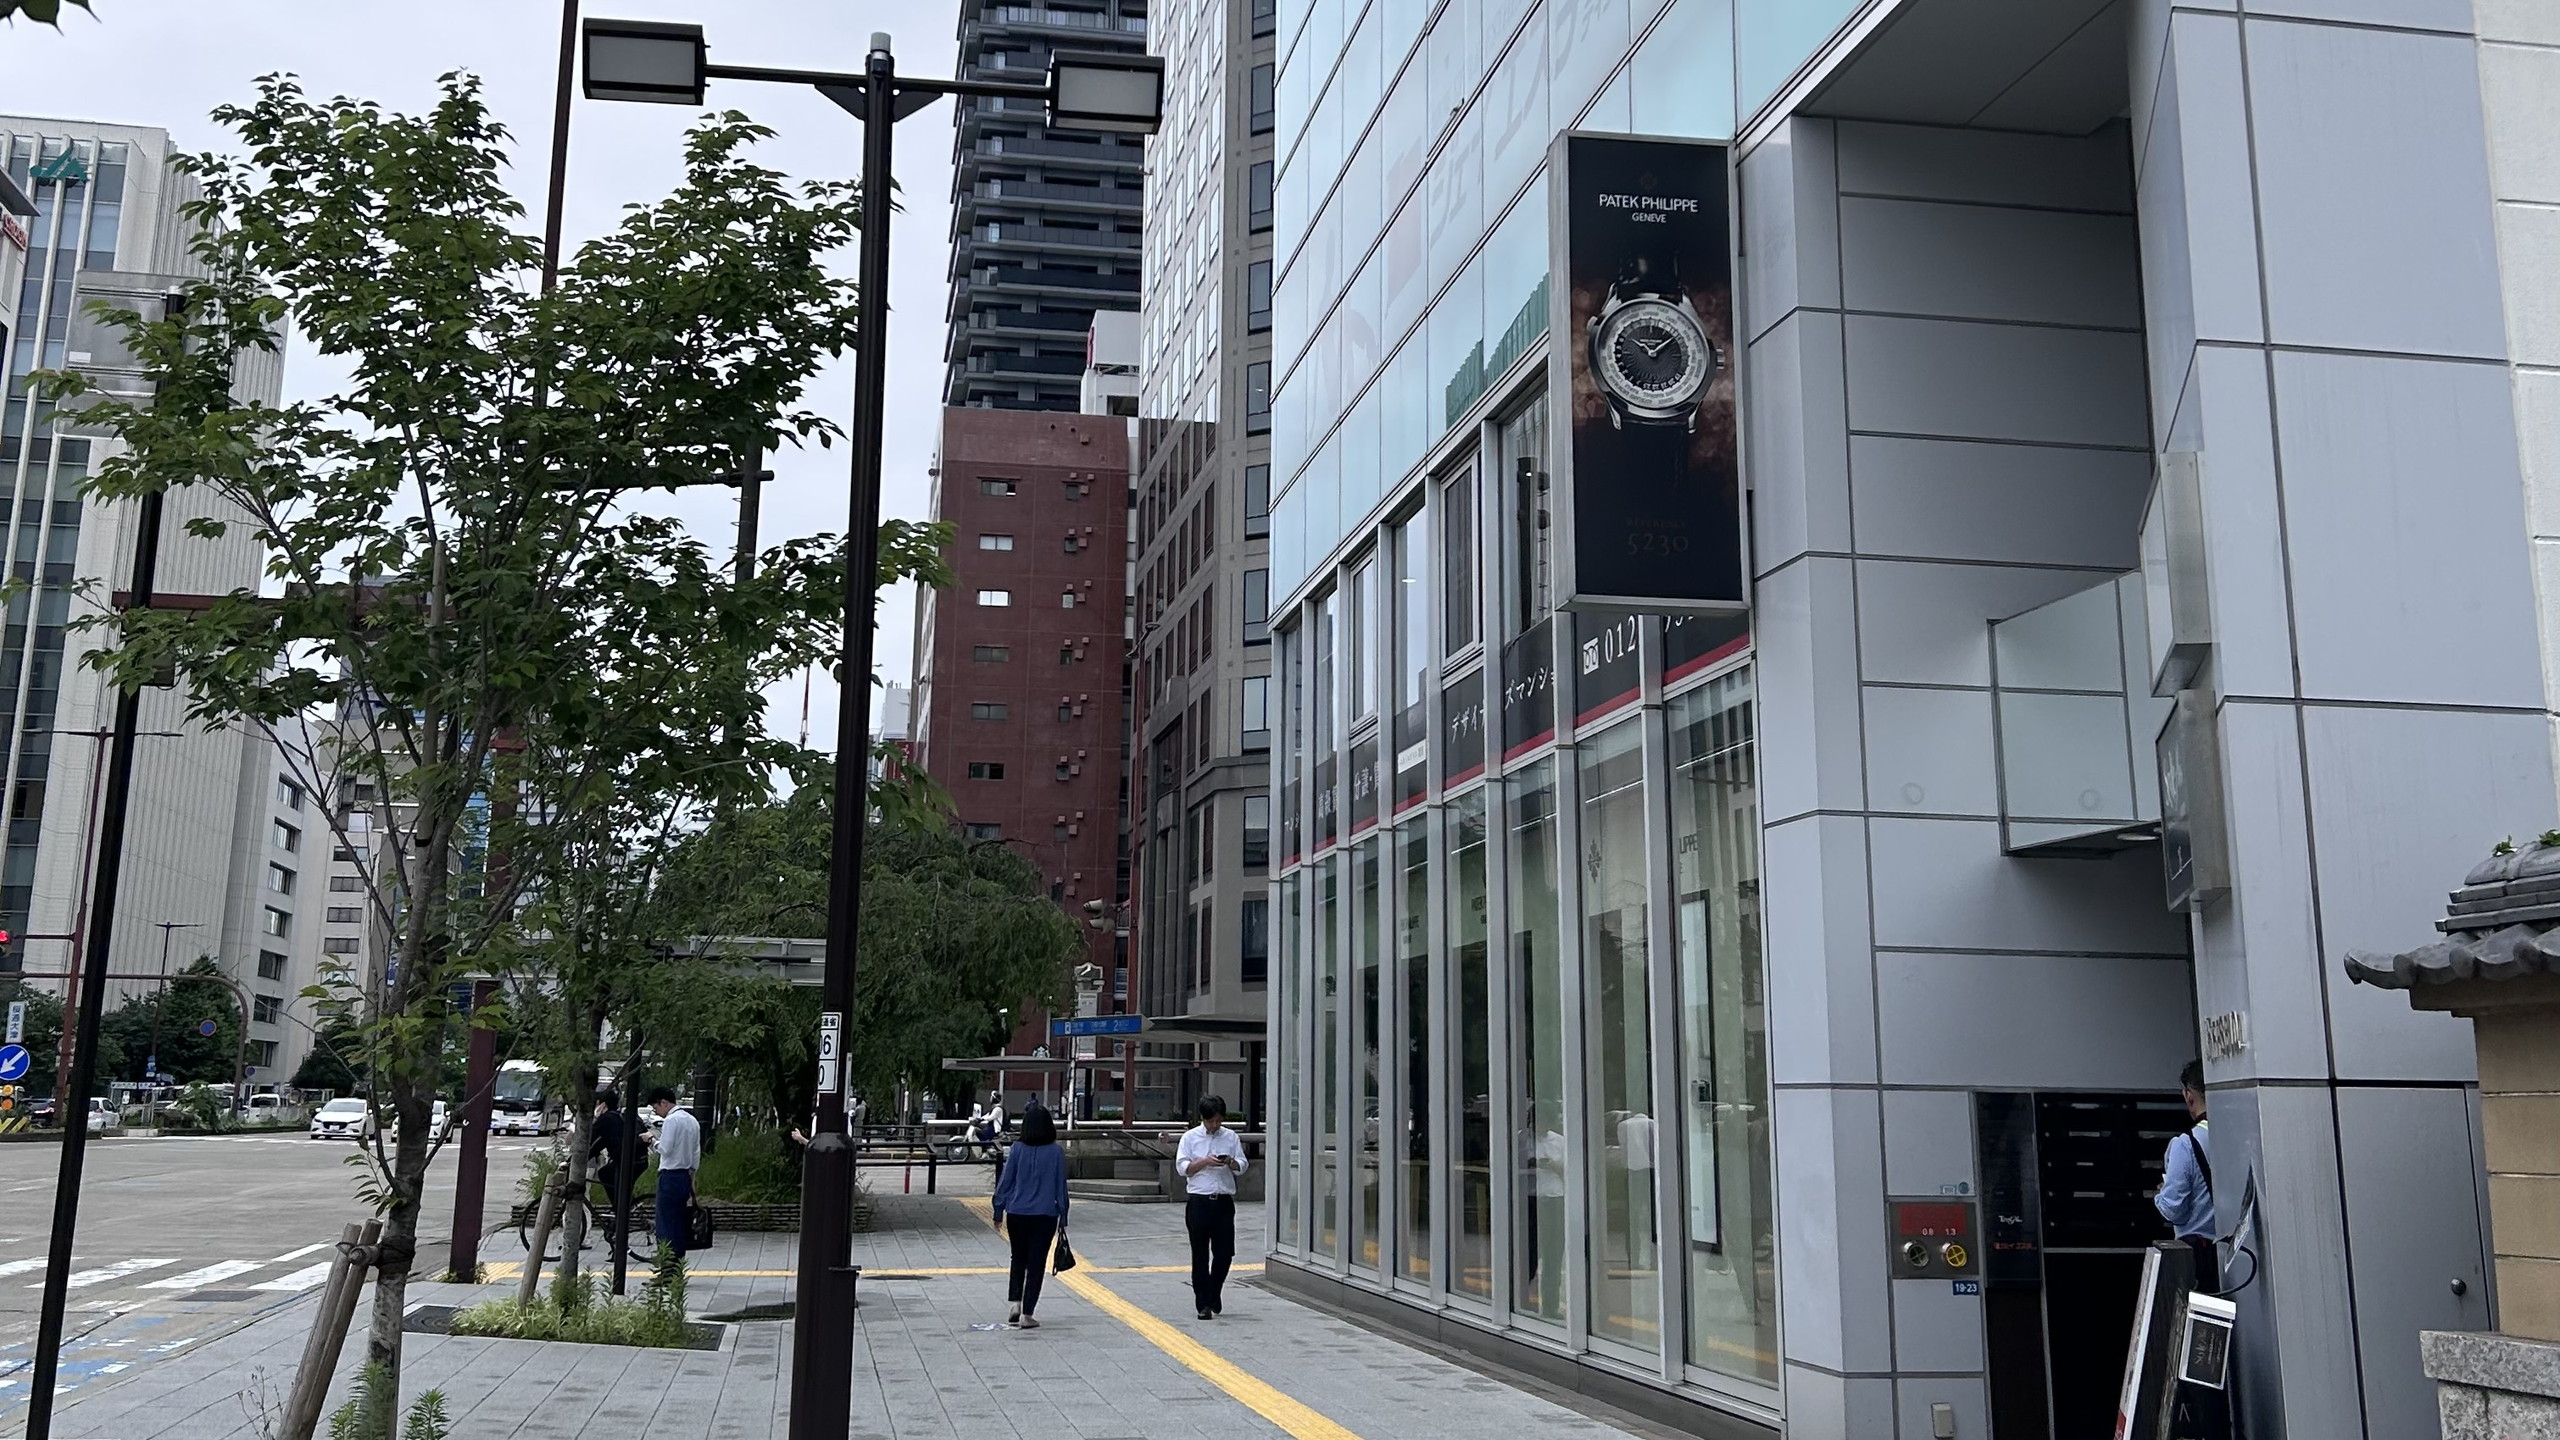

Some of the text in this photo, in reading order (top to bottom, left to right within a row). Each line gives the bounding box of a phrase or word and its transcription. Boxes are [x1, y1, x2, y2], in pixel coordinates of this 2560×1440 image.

[1599, 193, 1699, 213] PATEK PHILIPPE
[1631, 211, 1667, 223] GENEVE
[1627, 532, 1689, 557] 5230
